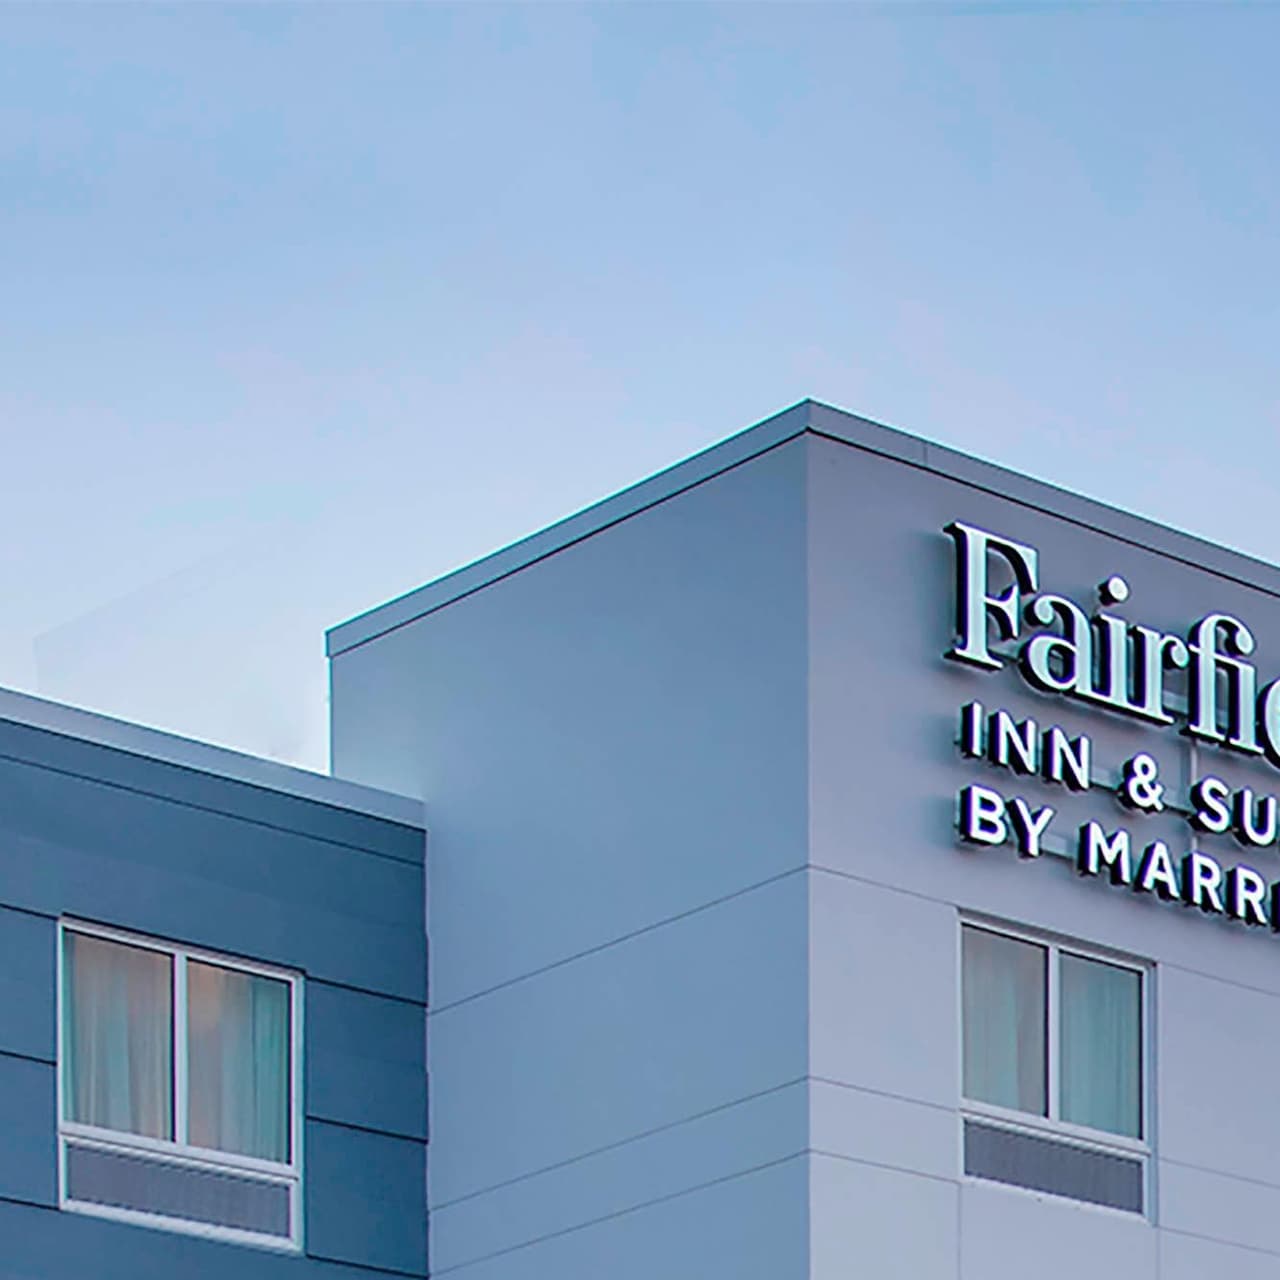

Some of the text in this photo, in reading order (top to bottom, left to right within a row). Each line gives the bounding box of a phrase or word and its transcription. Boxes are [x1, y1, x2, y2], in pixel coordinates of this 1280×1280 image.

[961, 701, 1091, 790] INN
[1119, 753, 1165, 813] &
[961, 784, 1055, 858] BY
